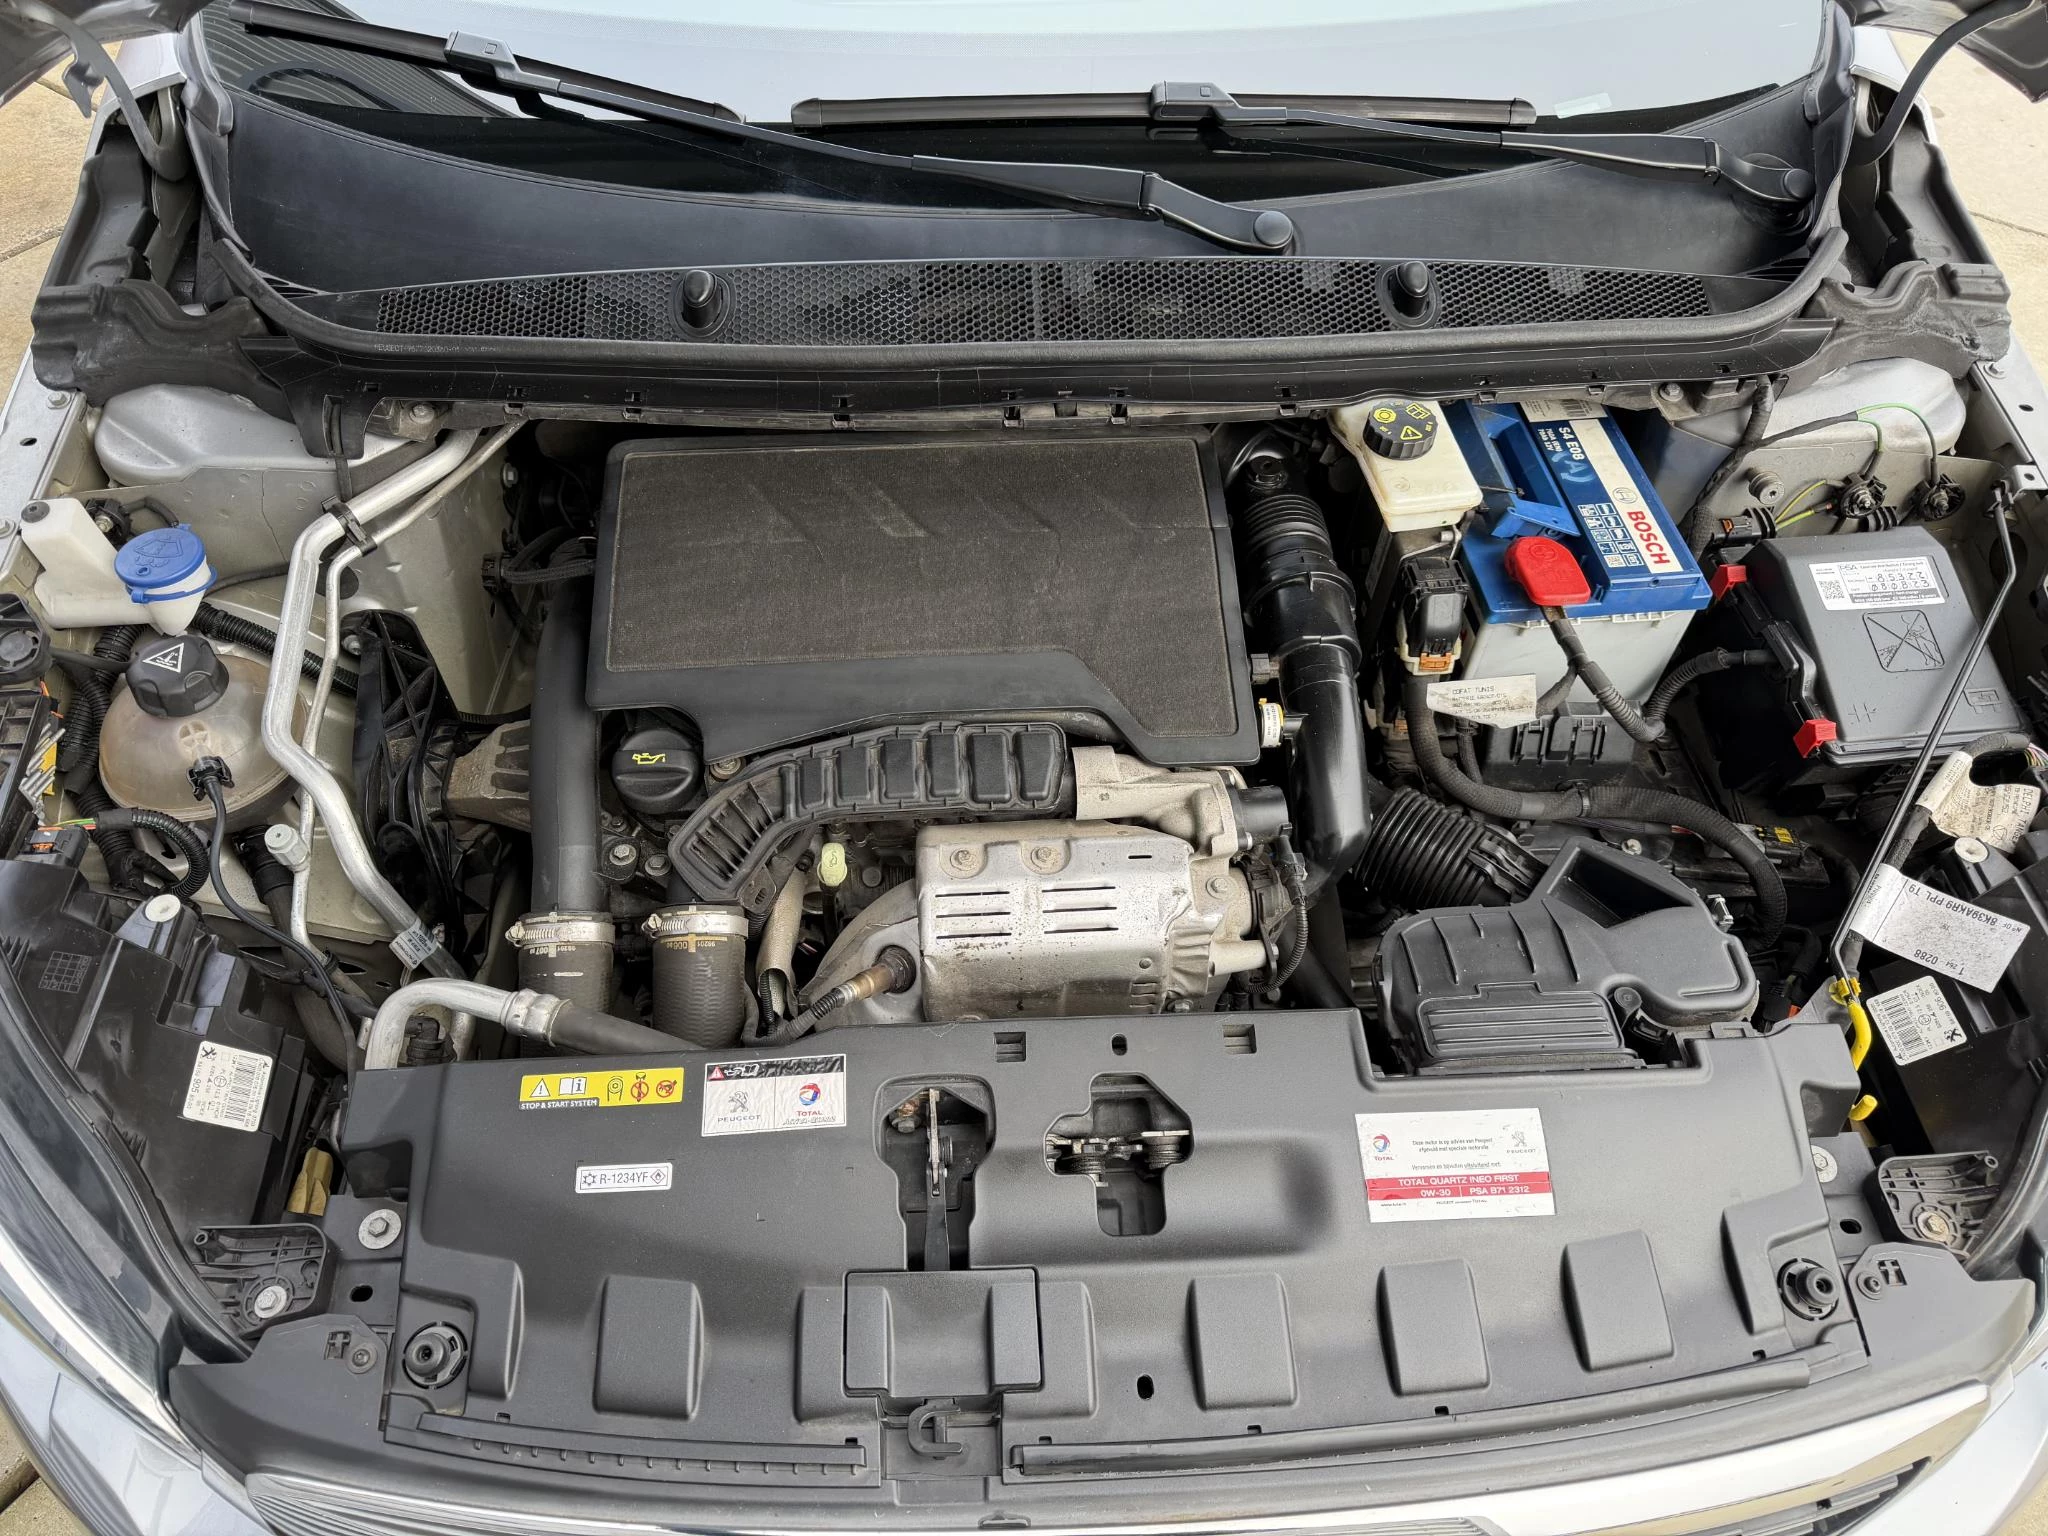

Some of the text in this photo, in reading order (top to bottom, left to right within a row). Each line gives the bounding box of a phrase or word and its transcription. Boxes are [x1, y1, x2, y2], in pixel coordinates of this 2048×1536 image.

[1559, 427, 1586, 460] S4 E08
[1627, 510, 1670, 564] BOSCH
[2021, 788, 2033, 814] DELPHI
[1909, 884, 1922, 896] T9
[1926, 890, 1946, 905] PPL
[1914, 949, 1939, 965] 0288
[1934, 996, 1946, 1010] 906
[191, 1078, 200, 1093] 905
[600, 1172, 648, 1184] R-1234YF
[1398, 1178, 1428, 1186] TOTAL
[1430, 1176, 1468, 1185] QUARTZ
[1420, 1189, 1451, 1197] 0W-30
